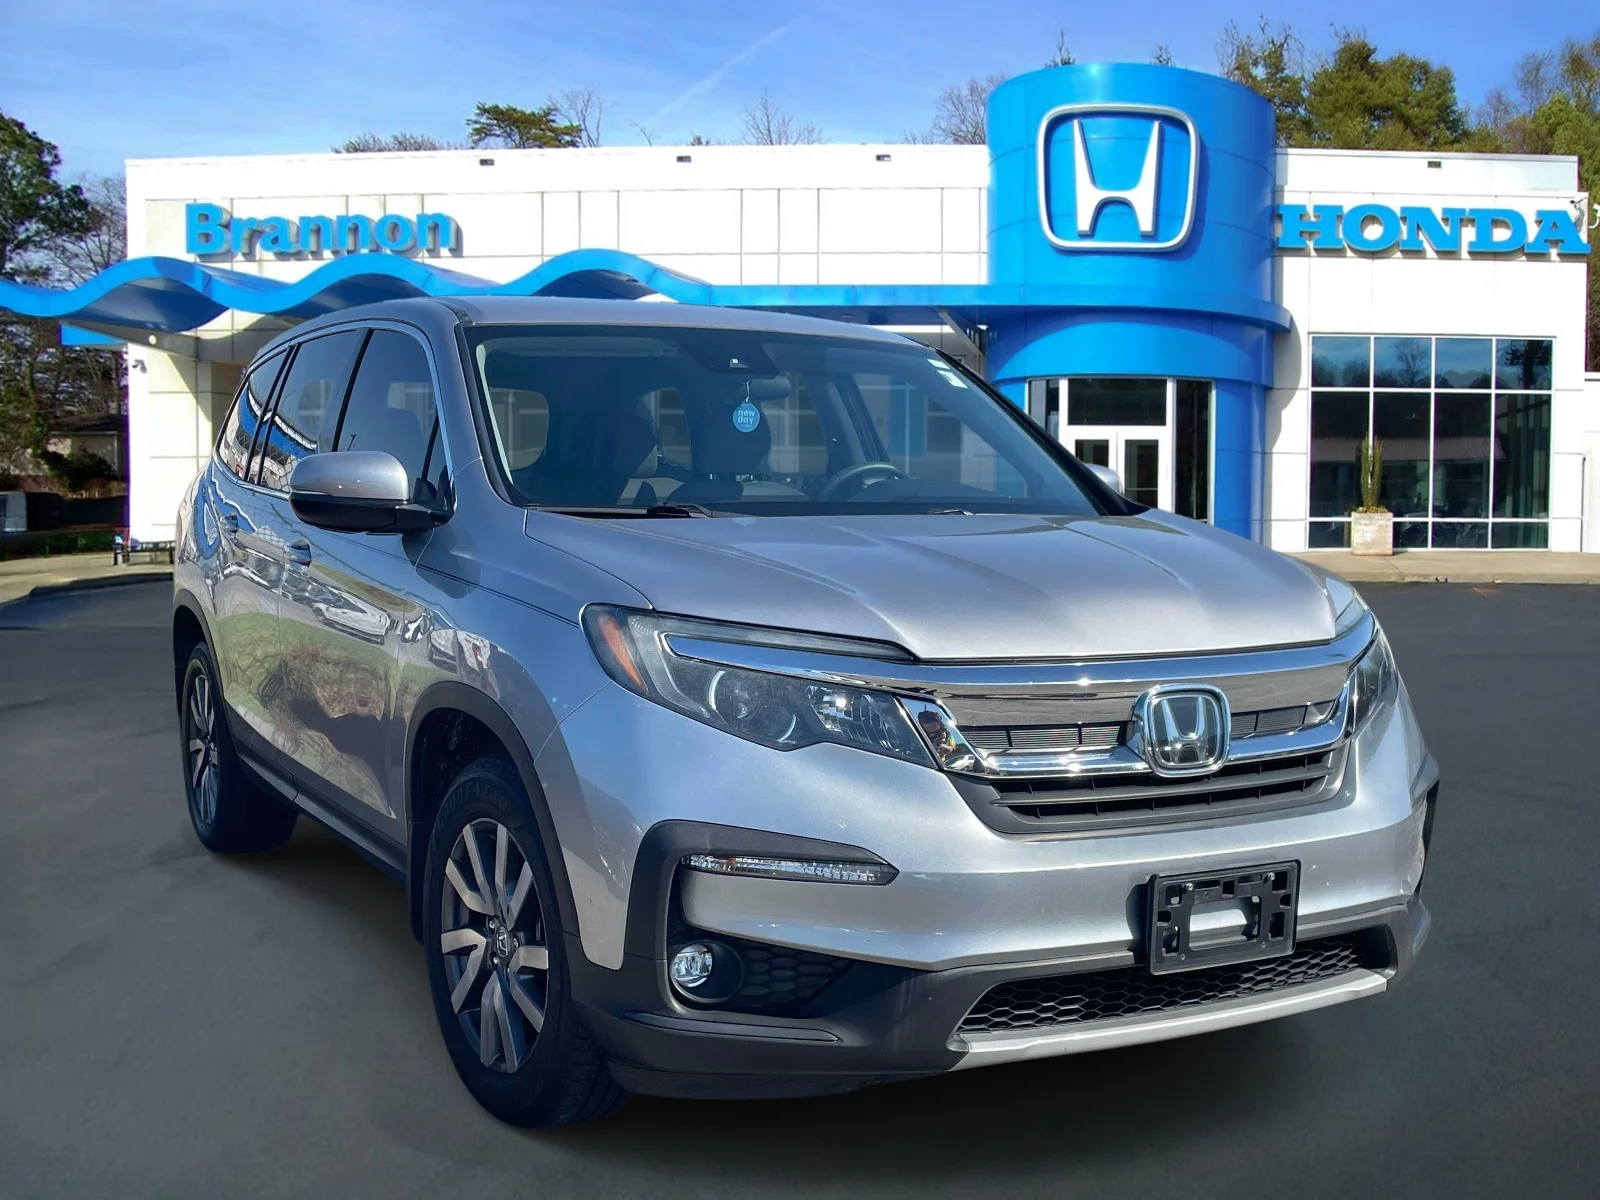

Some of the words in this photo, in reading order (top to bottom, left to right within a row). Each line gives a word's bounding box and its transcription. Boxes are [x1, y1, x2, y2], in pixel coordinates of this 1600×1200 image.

[185, 202, 457, 256] Brannon
[1276, 203, 1591, 255] HONDA
[737, 414, 754, 425] day
